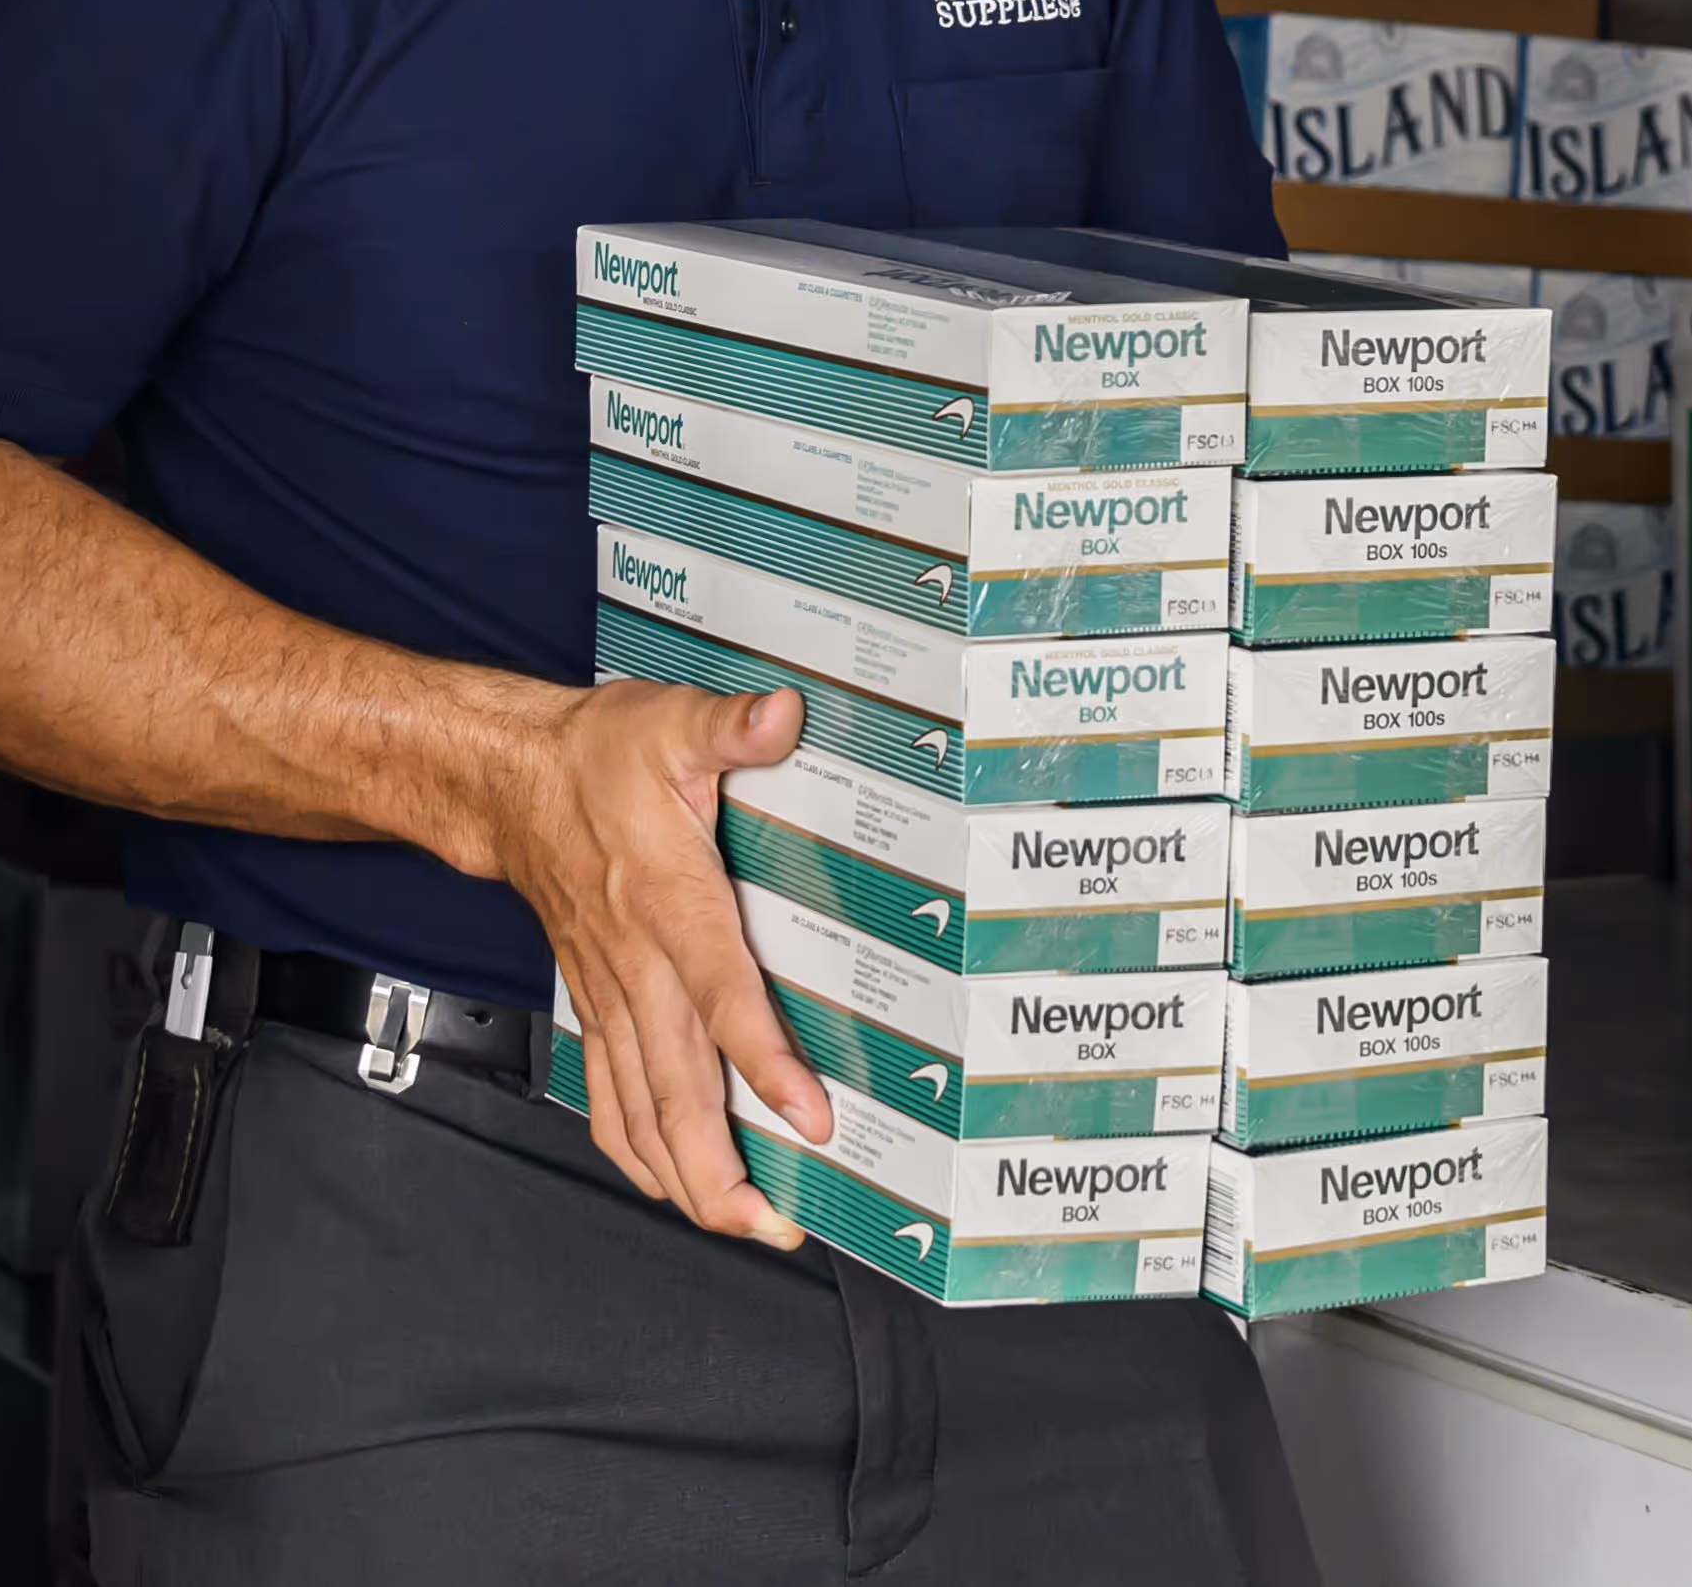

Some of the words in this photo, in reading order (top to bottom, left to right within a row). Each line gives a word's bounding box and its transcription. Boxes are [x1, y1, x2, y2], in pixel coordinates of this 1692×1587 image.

[1268, 63, 1515, 182] ISLAND
[594, 240, 678, 298] Newport
[1068, 313, 1118, 324] MENTHOL
[1123, 312, 1151, 323] GOLD
[1155, 311, 1198, 322] CLASSIC
[1035, 321, 1206, 367] Newport
[1321, 328, 1487, 373] Newport
[1102, 371, 1139, 388] BOX
[1364, 377, 1400, 393] BOX
[1407, 375, 1444, 392] 100s
[607, 390, 684, 448] Newport
[1491, 420, 1520, 434] FSC
[1523, 420, 1537, 431] H4
[1187, 434, 1218, 451] FSC
[1047, 481, 1099, 492] MENTHOL
[1103, 479, 1132, 490] GOLD
[1135, 477, 1179, 487] CLASSIC
[1015, 490, 1187, 534] Newport
[1325, 495, 1490, 539] Newport
[1081, 538, 1120, 555] BOX
[1367, 545, 1403, 561] BOX
[1411, 542, 1447, 559] 100s
[612, 541, 687, 603] Newport
[1495, 590, 1523, 605] FSC
[1526, 591, 1541, 602] H4
[1167, 599, 1198, 615] FSC
[1011, 656, 1186, 702] Newport
[1321, 662, 1488, 708] Newport
[1079, 706, 1117, 723] BOX
[1364, 713, 1400, 730] BOX
[1408, 711, 1445, 728] 100s
[1493, 753, 1522, 767] FSC
[1525, 753, 1539, 764] H4
[1165, 767, 1197, 783] FSC
[1011, 827, 1186, 873] Newport
[1315, 821, 1479, 869] Newport
[1080, 877, 1118, 895] BOX
[1357, 874, 1393, 892] BOX
[1401, 871, 1437, 888] 100s
[1486, 914, 1515, 930] FSC
[1517, 913, 1533, 925] H4
[1166, 929, 1197, 943] FSC
[1205, 928, 1219, 940] H4
[1011, 993, 1184, 1039] Newport
[1317, 983, 1481, 1035] Newport
[1078, 1043, 1116, 1061] BOX
[1359, 1038, 1396, 1057] BOX
[1403, 1035, 1440, 1053] 100s
[1489, 1071, 1518, 1088] FSC
[1521, 1071, 1536, 1083] H4
[1161, 1095, 1192, 1111] FSC
[1200, 1095, 1215, 1107] H4
[997, 1157, 1167, 1201] Newport
[1321, 1146, 1483, 1204] Newport
[1062, 1205, 1099, 1223] BOX
[1363, 1205, 1399, 1225] BOX
[1407, 1199, 1442, 1218] 100s
[1491, 1235, 1519, 1251] FSC
[1523, 1233, 1537, 1245] H4
[1143, 1256, 1173, 1271] FSC
